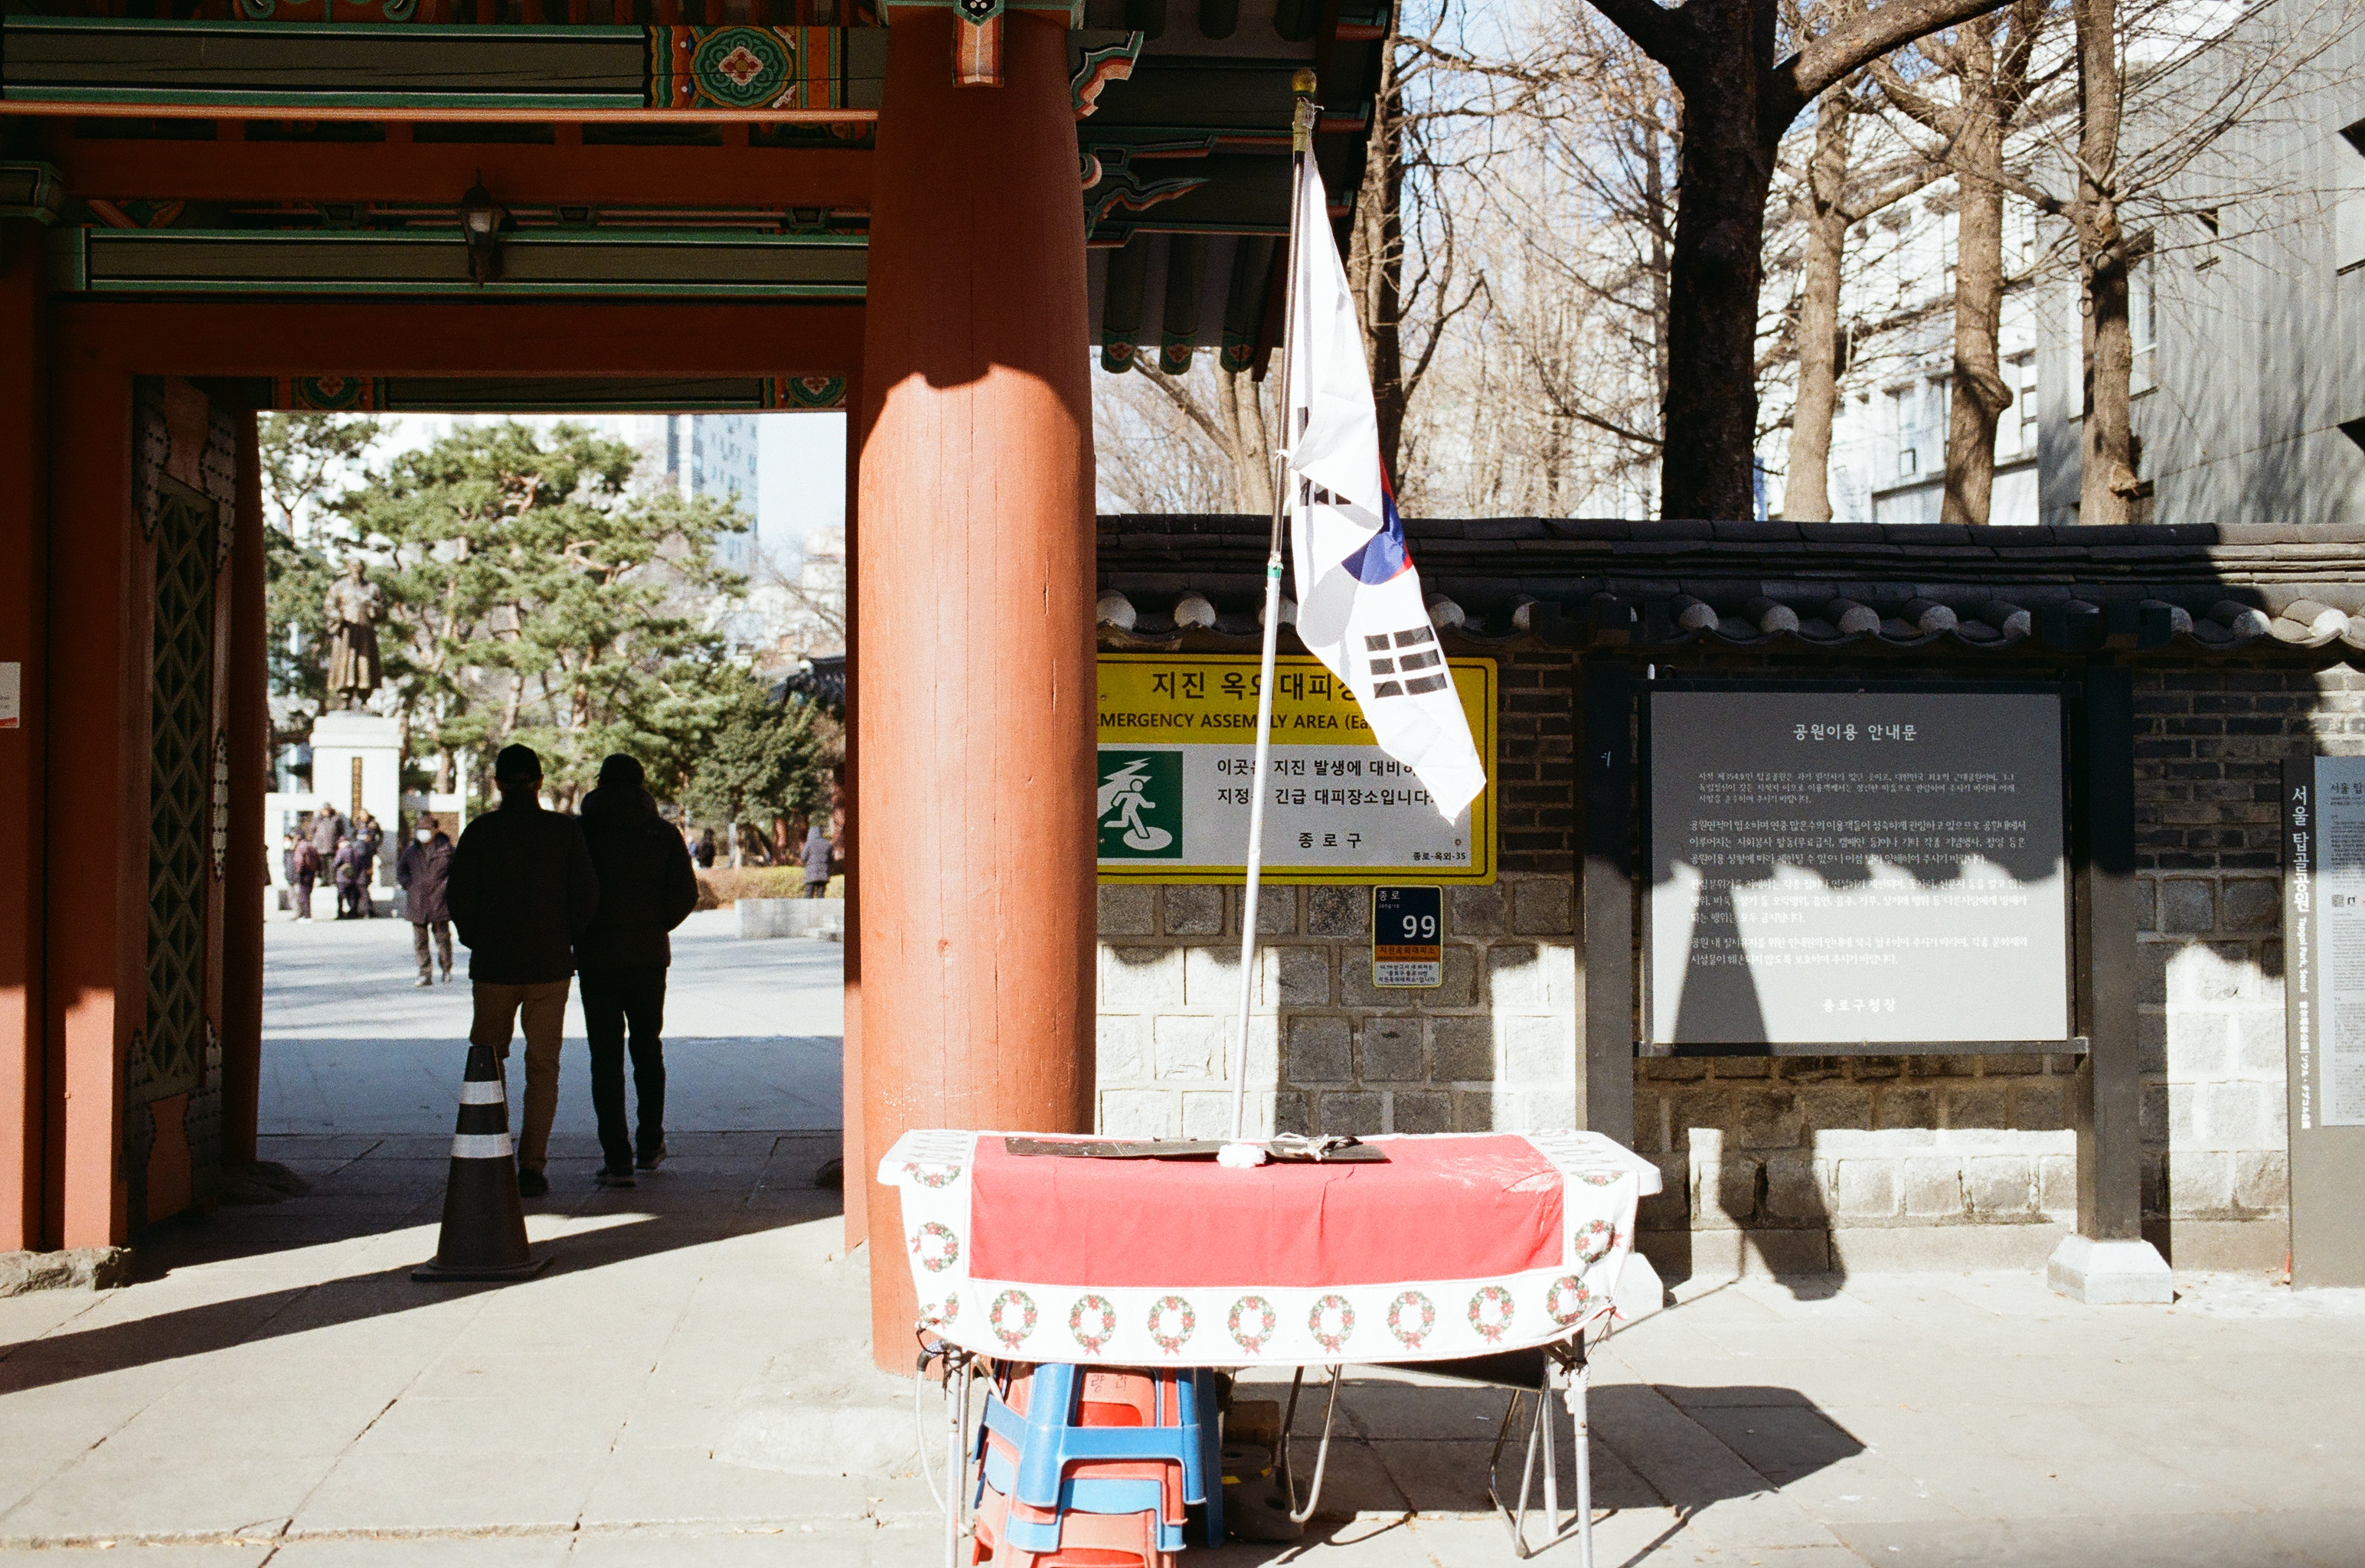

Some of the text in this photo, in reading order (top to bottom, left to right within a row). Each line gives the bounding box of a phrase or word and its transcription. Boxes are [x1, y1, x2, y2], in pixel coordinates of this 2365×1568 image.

[1152, 671, 1205, 700] 지진
[1200, 713, 1287, 730] ASSEMLY
[1293, 714, 1339, 730] AREA
[1792, 723, 1919, 742] 공원이용 안내문
[1217, 759, 1256, 776] 이곳
[1274, 760, 1305, 776] 지진
[1314, 760, 1361, 777] 발생에
[1217, 788, 1254, 805] 지정
[1275, 789, 1307, 805] 긴급
[1690, 820, 1732, 831] 공원면적이
[1734, 820, 1769, 831] 협소하며
[1770, 820, 1788, 831] 연중
[1826, 820, 1870, 831] 이용객들이
[1873, 820, 1907, 831] 정숙하게
[1909, 820, 1944, 831] 관람하고
[1945, 820, 1981, 831] 있으므로
[1689, 837, 1732, 848] 이루어지는
[1737, 837, 1772, 848] 사회봉사
[1839, 837, 1865, 848] 캠페인
[1903, 837, 1919, 848] 기타
[1924, 837, 1940, 848] 각종
[2009, 837, 2025, 848] 등은
[2292, 785, 2311, 913] 서울 탑골공원
[1413, 851, 1466, 861] 종로-옥외-35
[1690, 853, 1723, 865] 공원이용
[1726, 853, 1754, 865] 상황에
[1756, 853, 1775, 865] 따라
[1807, 853, 1815, 865] 수
[1922, 853, 1948, 865] 주시기
[1761, 895, 1768, 906] 등
[1739, 912, 1758, 923] 모두
[1402, 915, 1436, 939] 99
[2297, 916, 2308, 946] Tapgol
[1691, 937, 1709, 949] 공원
[1913, 937, 1938, 949] 주시기
[1691, 954, 1726, 965] 시설물이
[2298, 970, 2308, 993] Seoul
[1822, 998, 1896, 1014] 종로구청장
